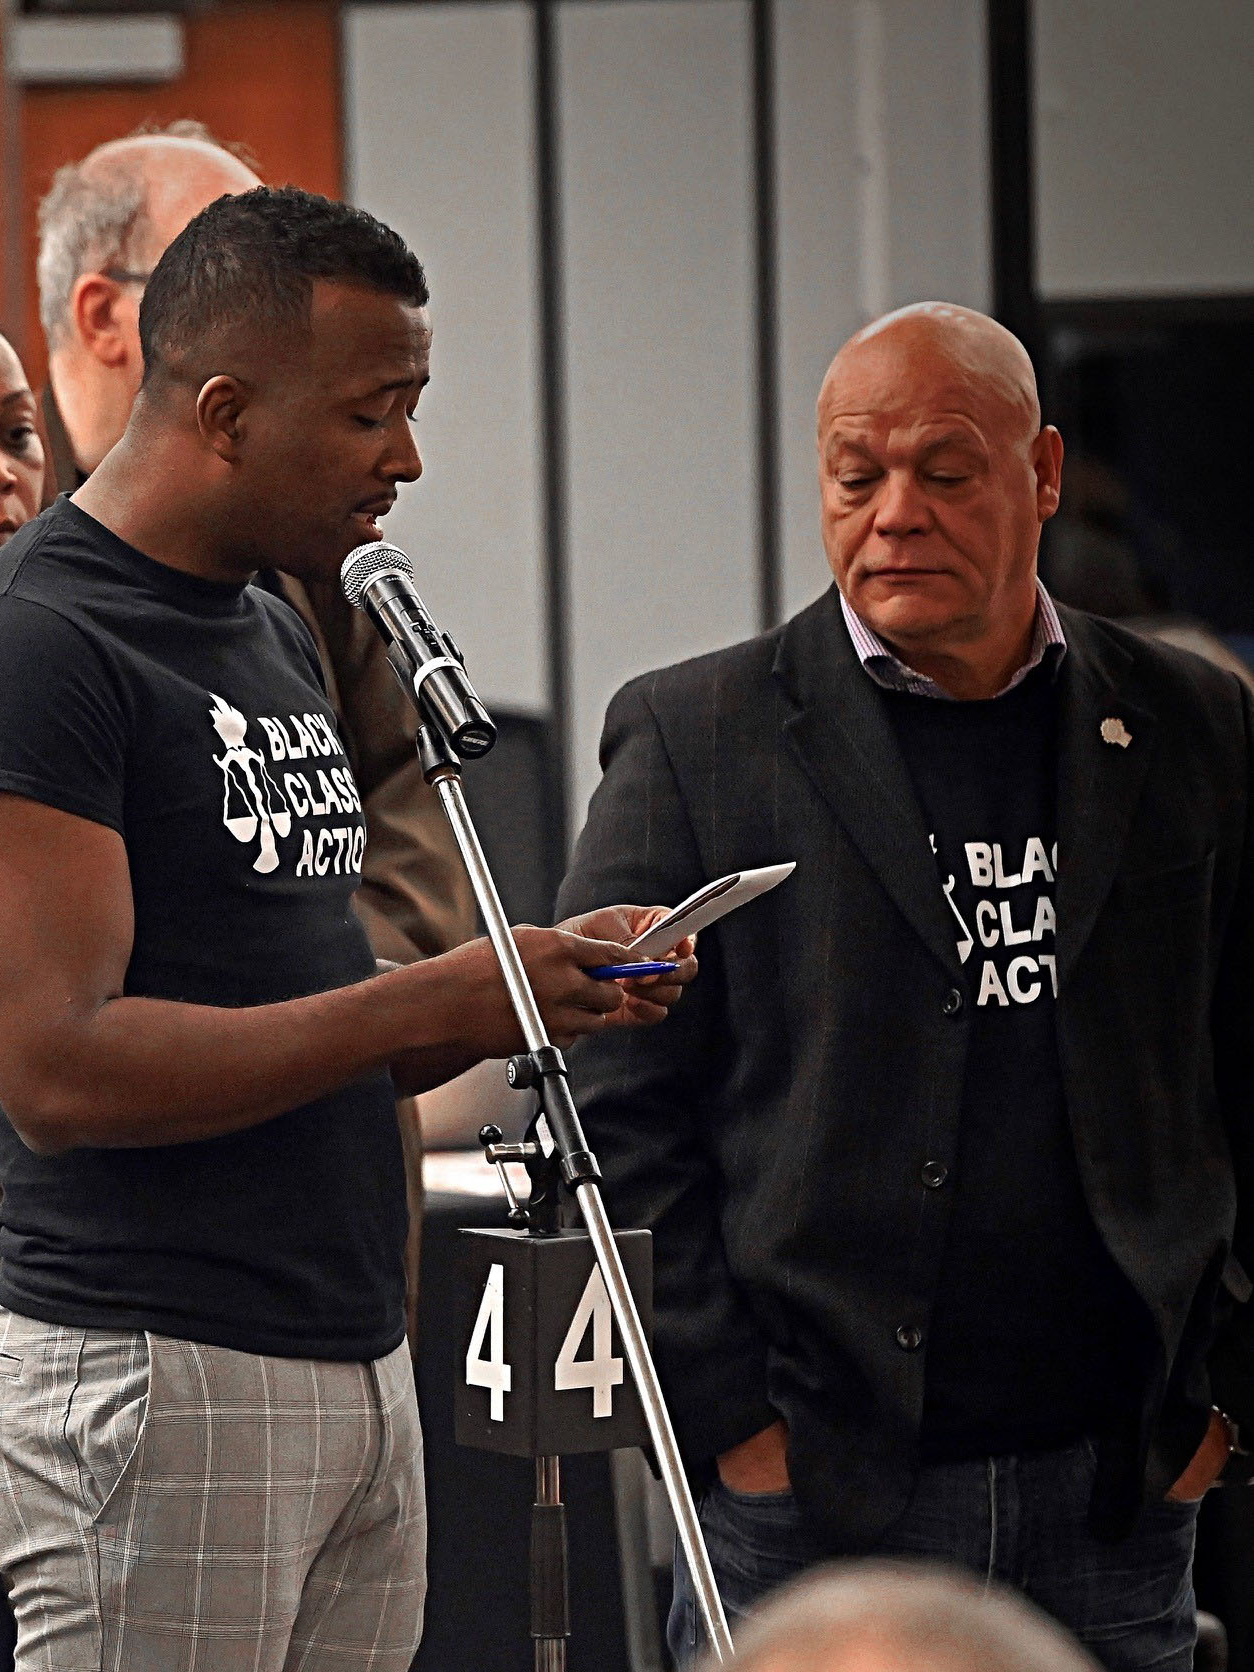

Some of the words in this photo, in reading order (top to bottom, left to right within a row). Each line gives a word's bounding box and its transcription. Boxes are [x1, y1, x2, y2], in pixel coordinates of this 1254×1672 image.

[257, 713, 344, 762] BLACK
[284, 767, 362, 818] CLASS
[296, 826, 367, 877] ACTIO
[964, 837, 1057, 888] BLA
[975, 896, 1056, 947] CLA
[976, 955, 1058, 1006] ACT
[465, 1263, 512, 1422] 4
[554, 1261, 624, 1419] 4
